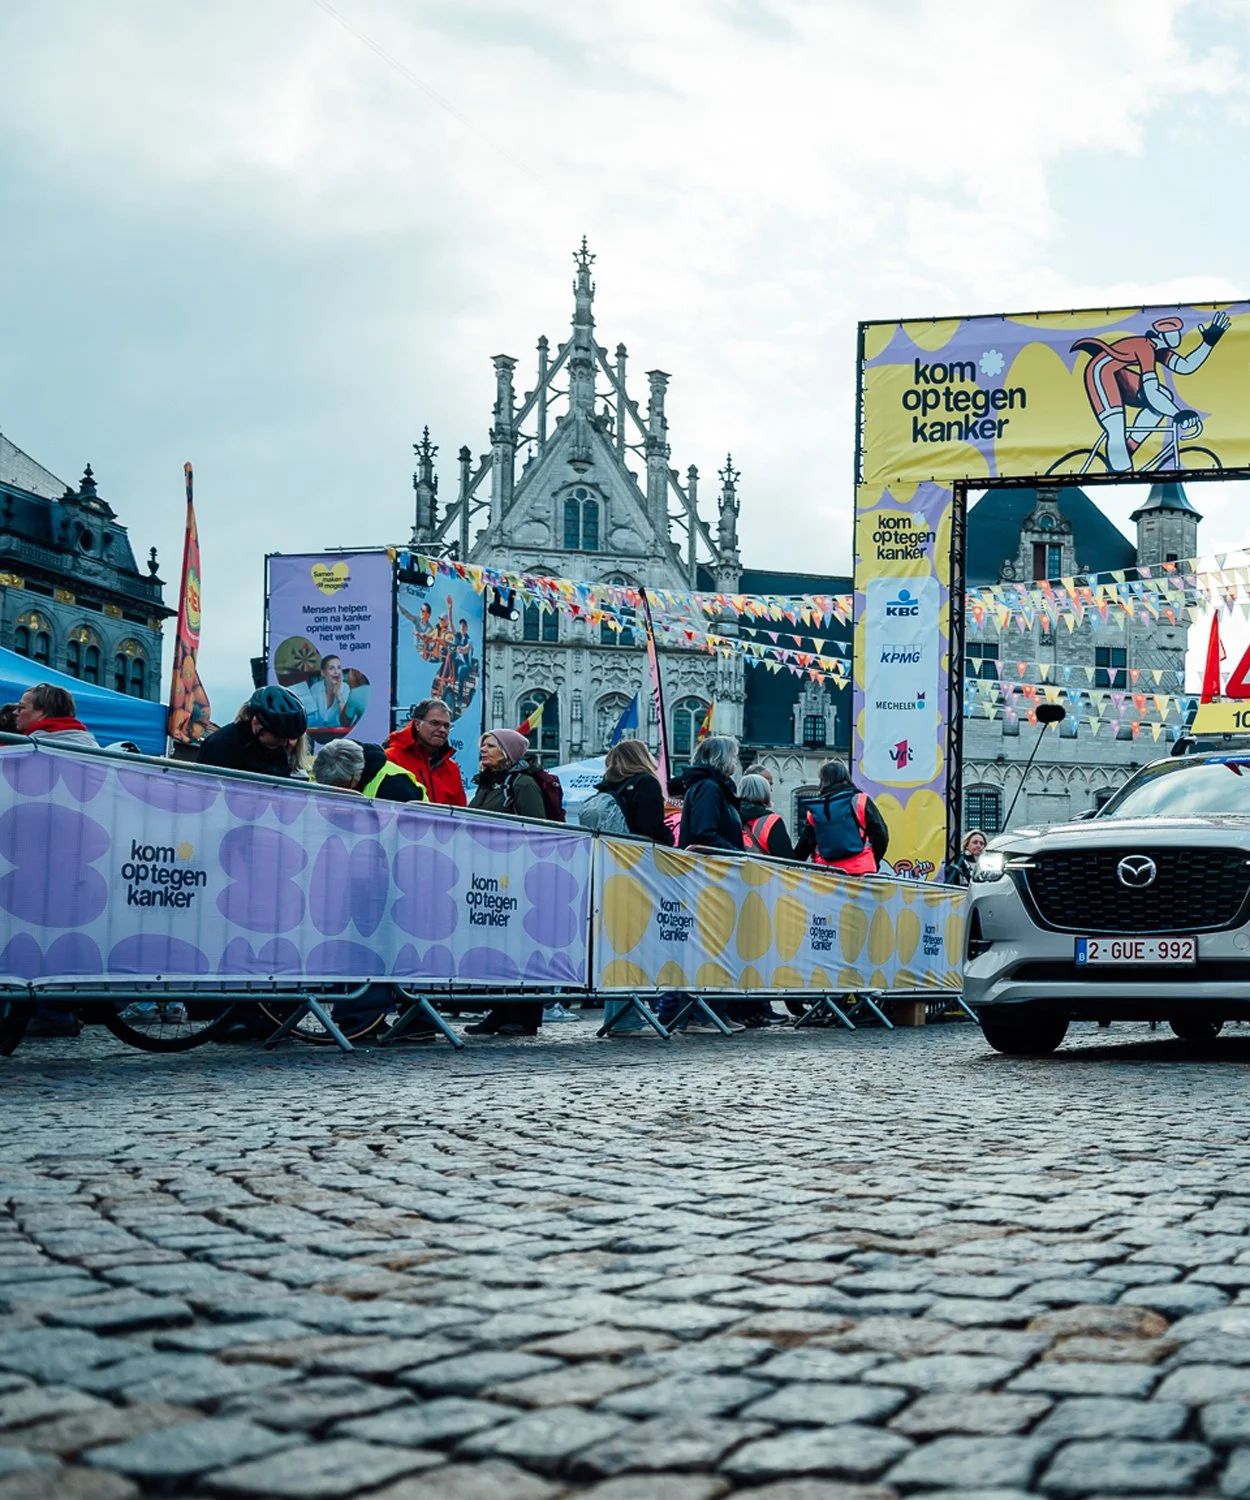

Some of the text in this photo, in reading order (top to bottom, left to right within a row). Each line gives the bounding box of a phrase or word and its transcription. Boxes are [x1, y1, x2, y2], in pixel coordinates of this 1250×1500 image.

[914, 357, 977, 386] kom
[912, 413, 1010, 443] kanker
[878, 514, 912, 529] kom
[877, 545, 927, 560] kanker
[302, 604, 367, 614] Mensen helpen
[886, 607, 919, 616] KBC
[314, 615, 328, 623] om
[342, 613, 372, 622] kanker
[306, 623, 360, 634] opnieuw aan
[319, 632, 356, 641] het werk
[339, 642, 371, 652] te gaan
[880, 652, 921, 664] KPMG
[876, 701, 916, 710] MECHELEN
[131, 839, 175, 864] kom
[471, 872, 498, 892] kom
[127, 884, 195, 908] kanker
[660, 896, 680, 913] kom
[470, 907, 511, 928] kanker
[812, 913, 827, 926] kom
[660, 926, 689, 942] kanker
[811, 938, 833, 951] kanker
[1079, 952, 1086, 961] B
